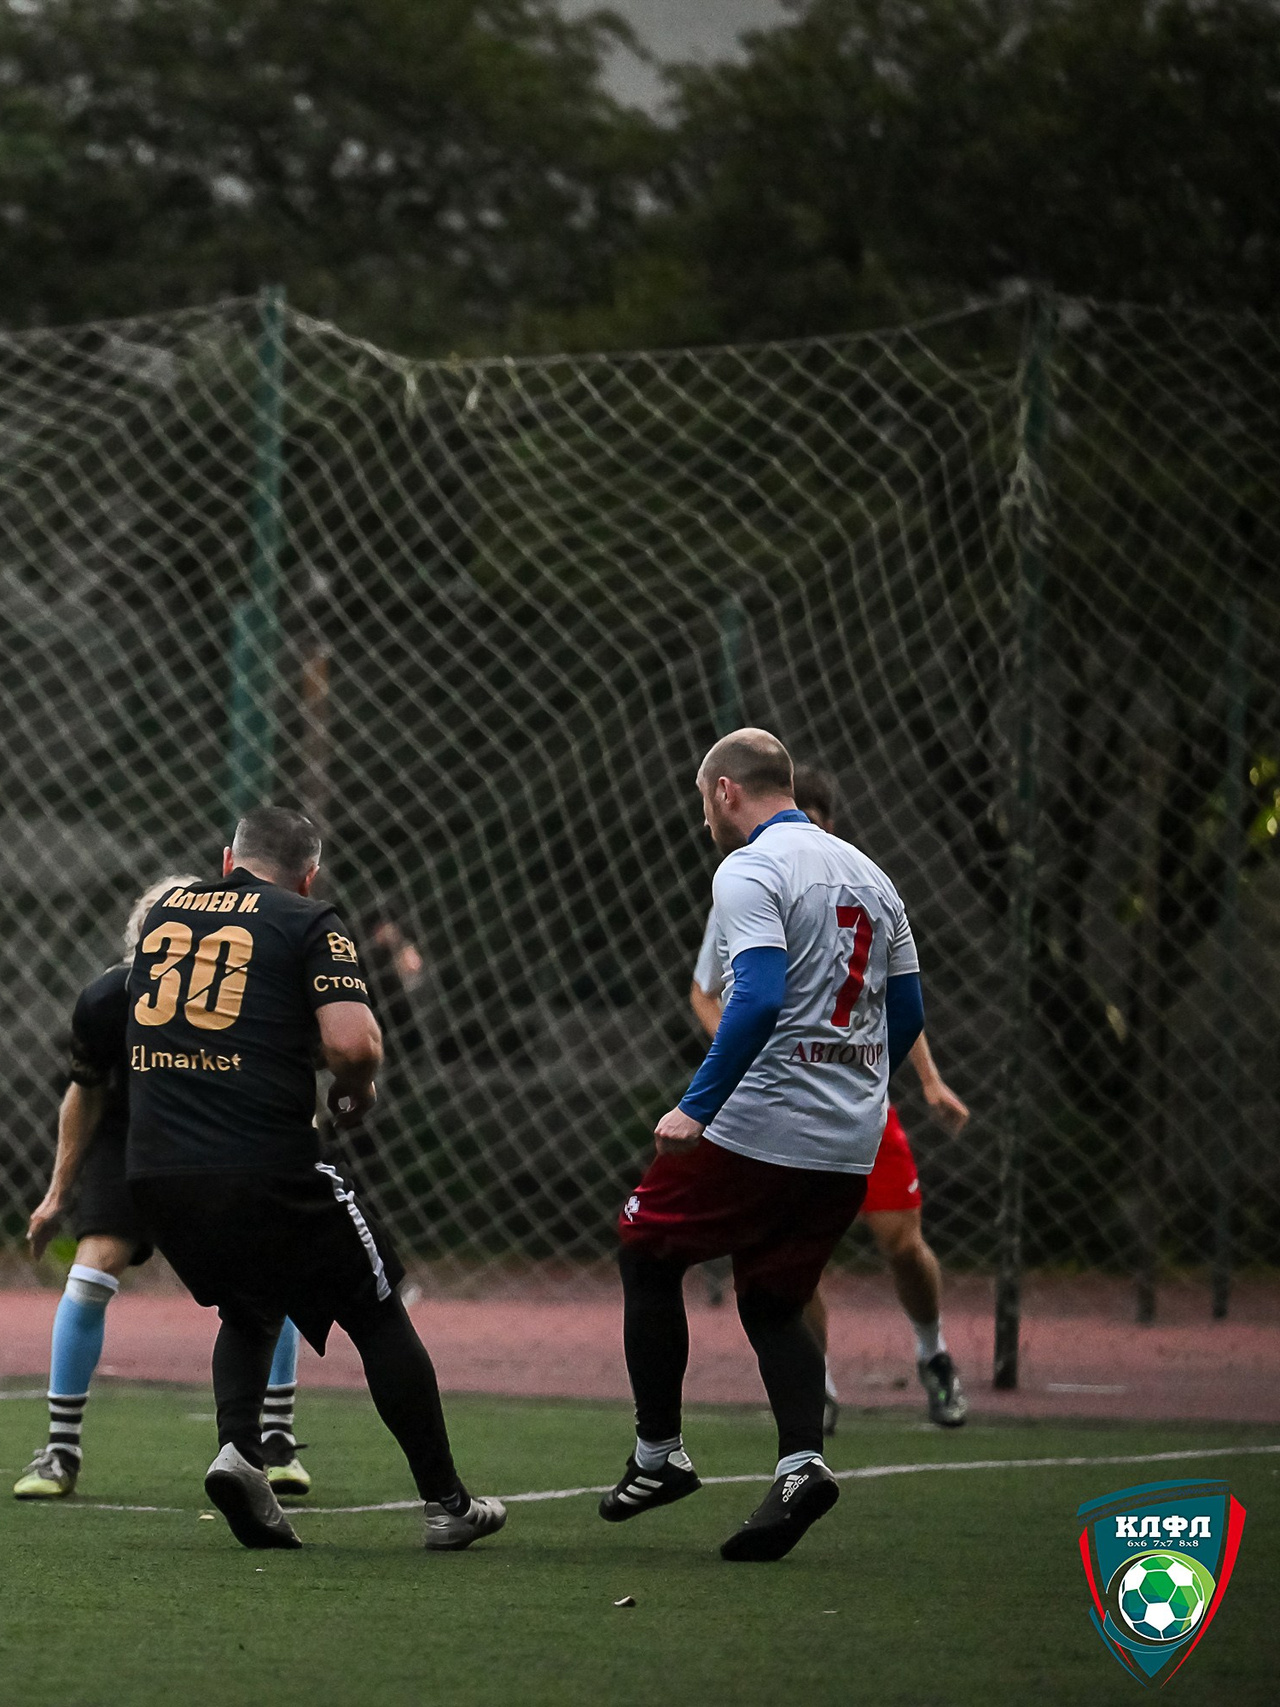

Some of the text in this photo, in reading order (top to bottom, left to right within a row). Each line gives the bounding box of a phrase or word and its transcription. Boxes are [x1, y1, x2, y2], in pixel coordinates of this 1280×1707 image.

[134, 921, 253, 1030] 30
[831, 906, 873, 1027] 7
[789, 1041, 883, 1066] АВТОТОР
[782, 1474, 810, 1502] adidas
